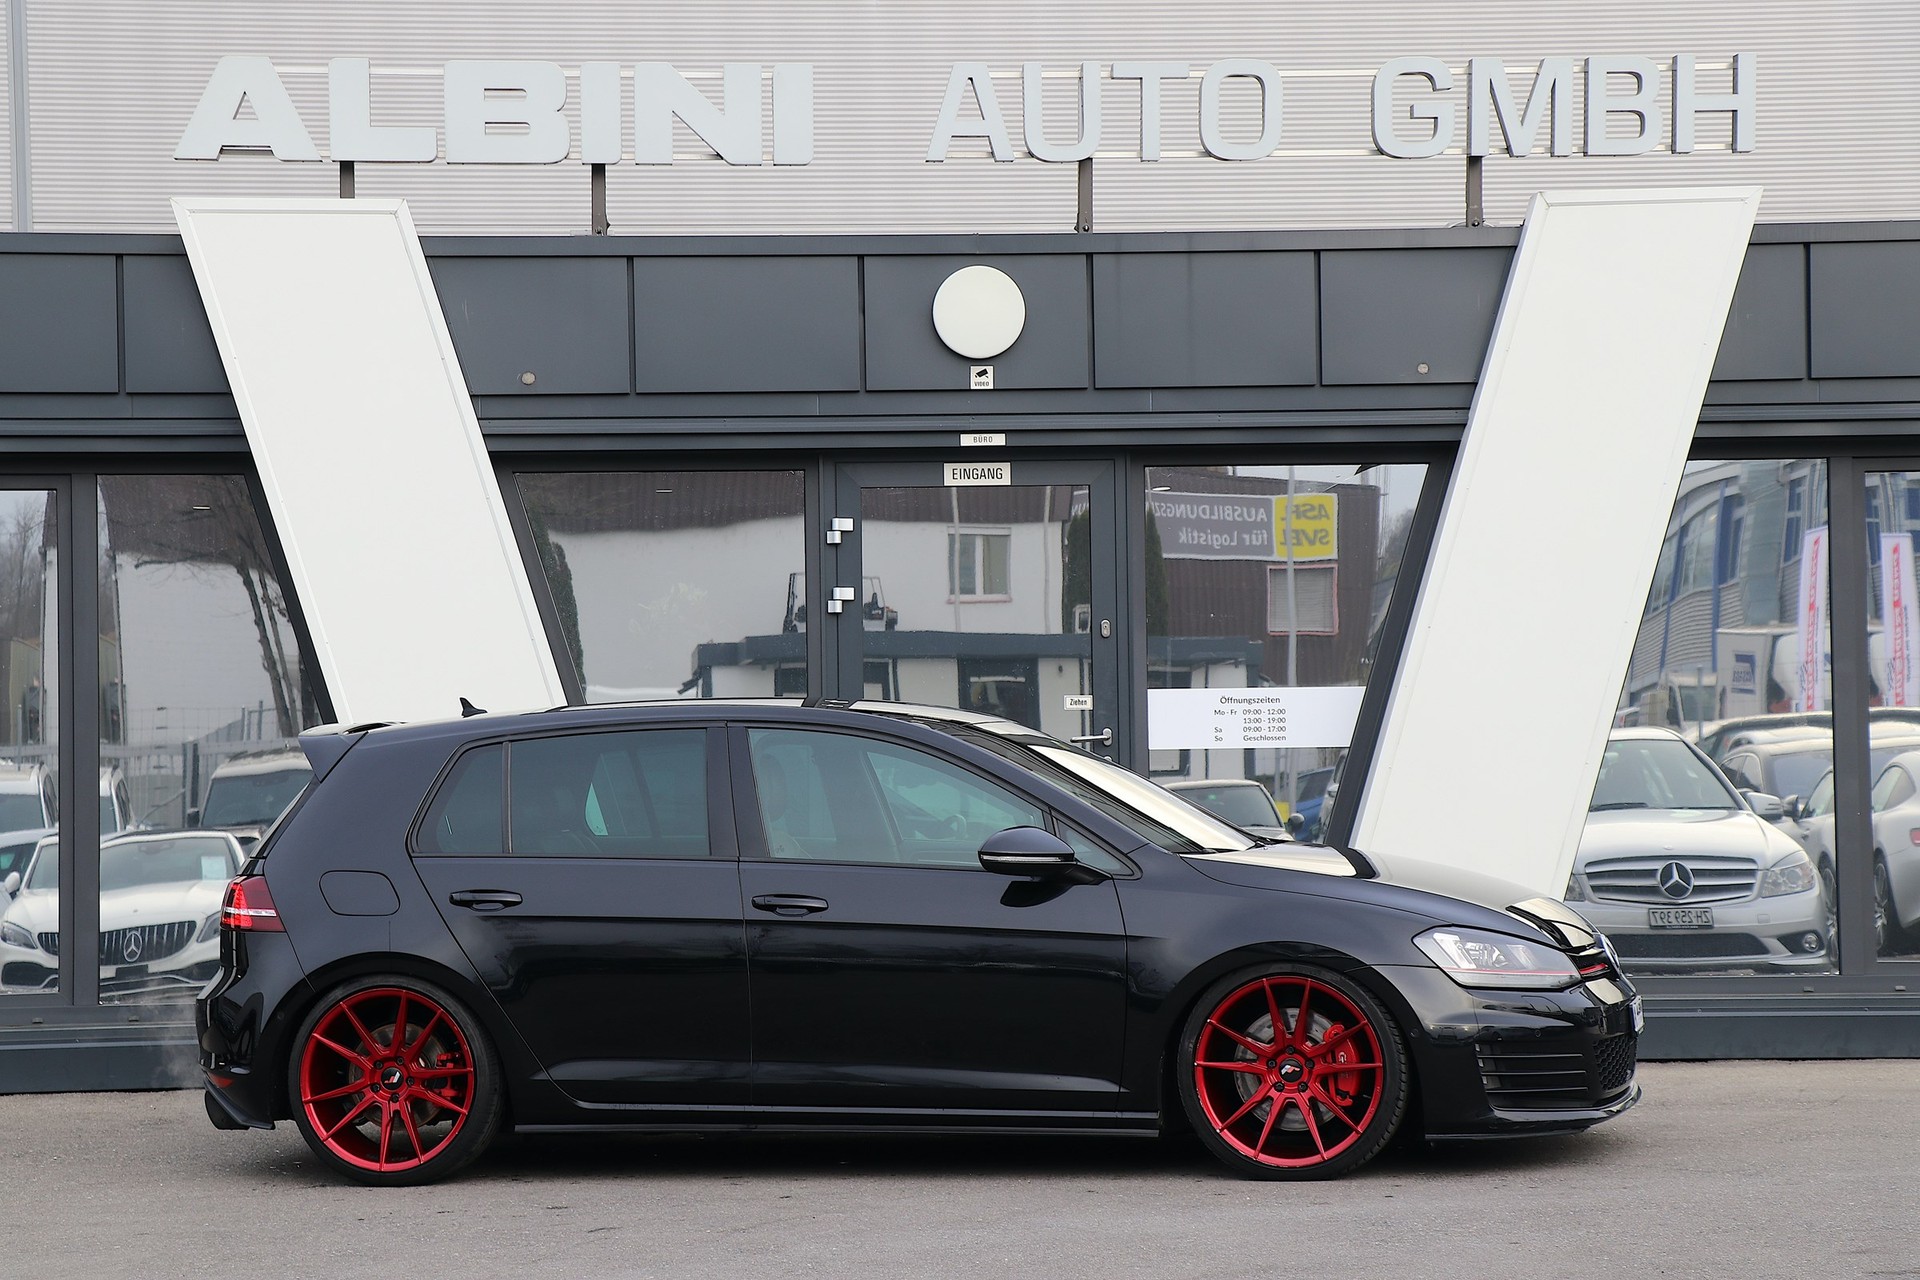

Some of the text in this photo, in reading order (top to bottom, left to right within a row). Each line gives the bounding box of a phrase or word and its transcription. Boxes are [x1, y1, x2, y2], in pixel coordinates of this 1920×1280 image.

[173, 52, 1758, 166] ALBINI AUTO GMBH
[973, 434, 993, 443] BÜRO
[952, 467, 1003, 480] EINGANG
[1070, 698, 1088, 706] Ziehen
[1219, 696, 1281, 705] Öffnungszeiten
[1243, 734, 1287, 742] Geschlossen
